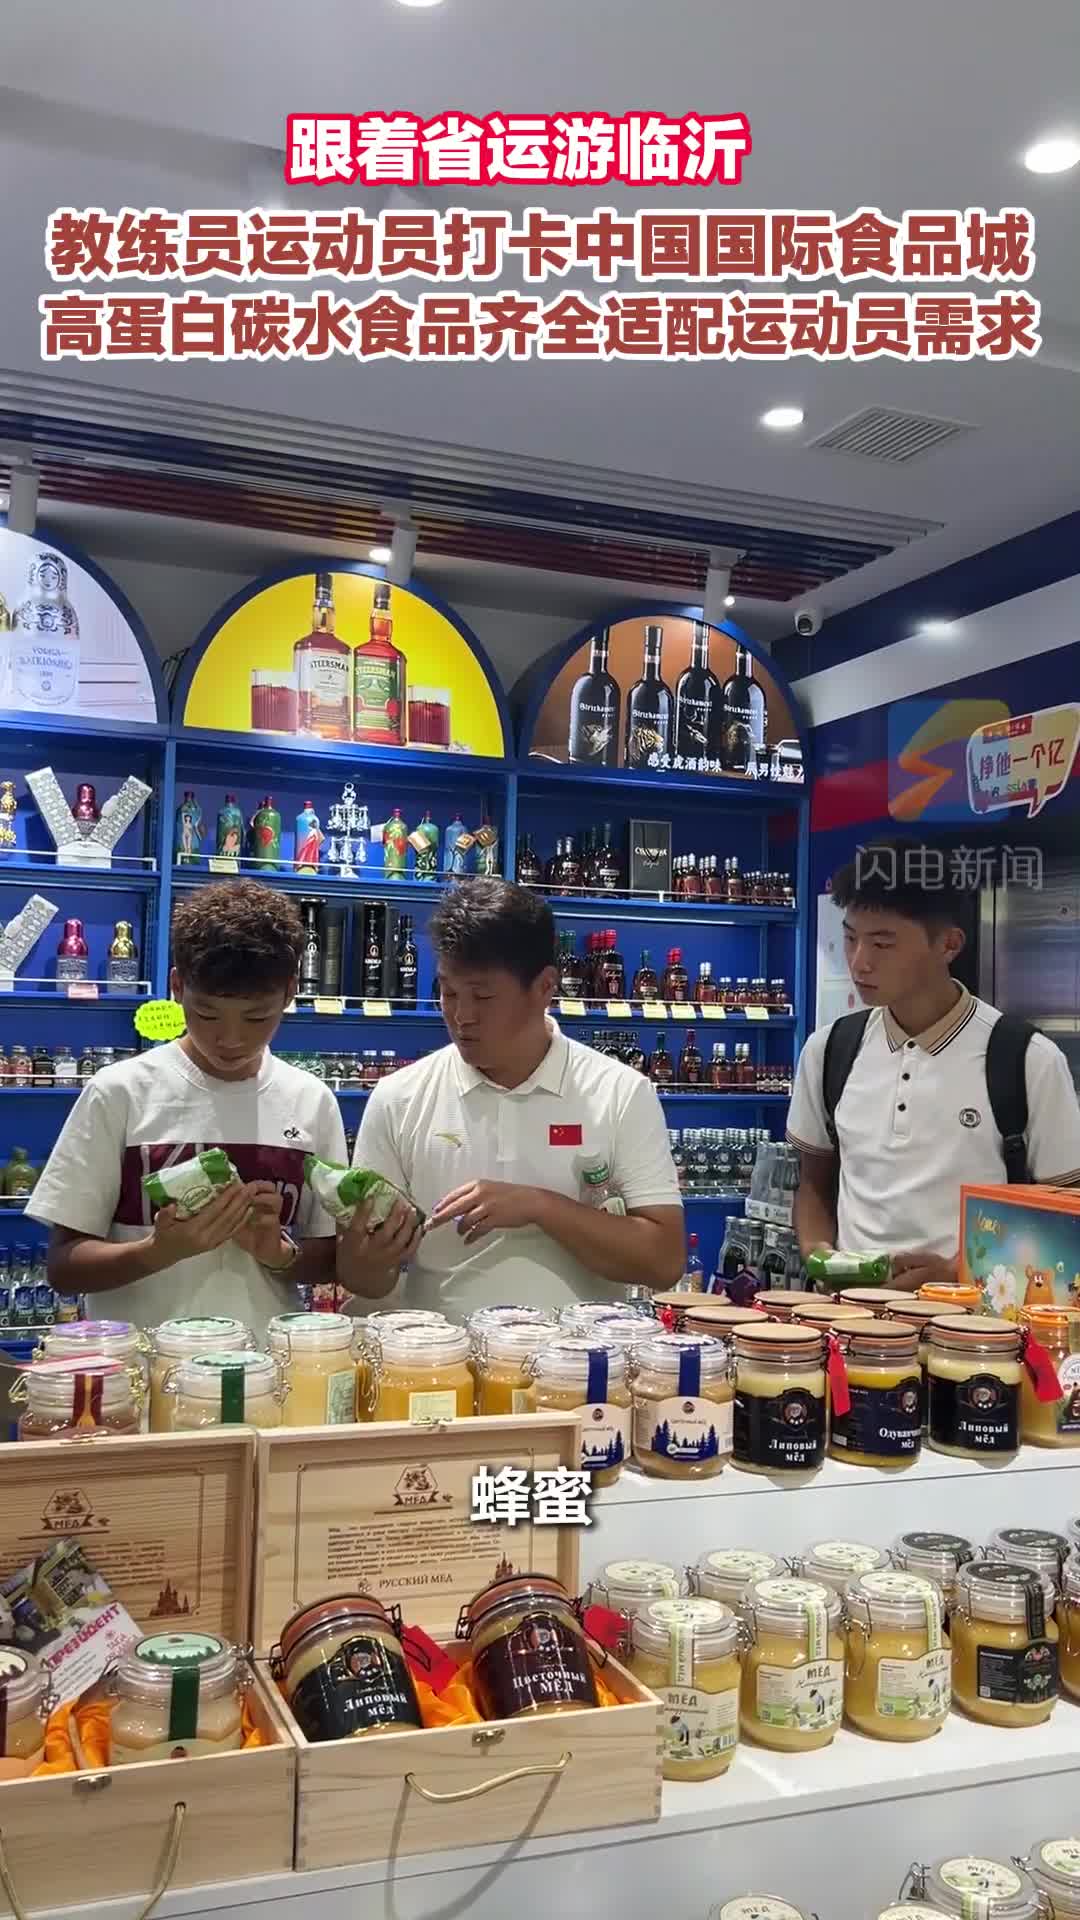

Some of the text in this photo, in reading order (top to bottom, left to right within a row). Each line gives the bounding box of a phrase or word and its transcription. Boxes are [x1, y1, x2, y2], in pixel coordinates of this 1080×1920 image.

[958, 1421, 1009, 1433] Липовый
[768, 1439, 817, 1450] Липовый
[379, 1574, 428, 1588] РУССКИЙ
[343, 1693, 408, 1712] Липовый
